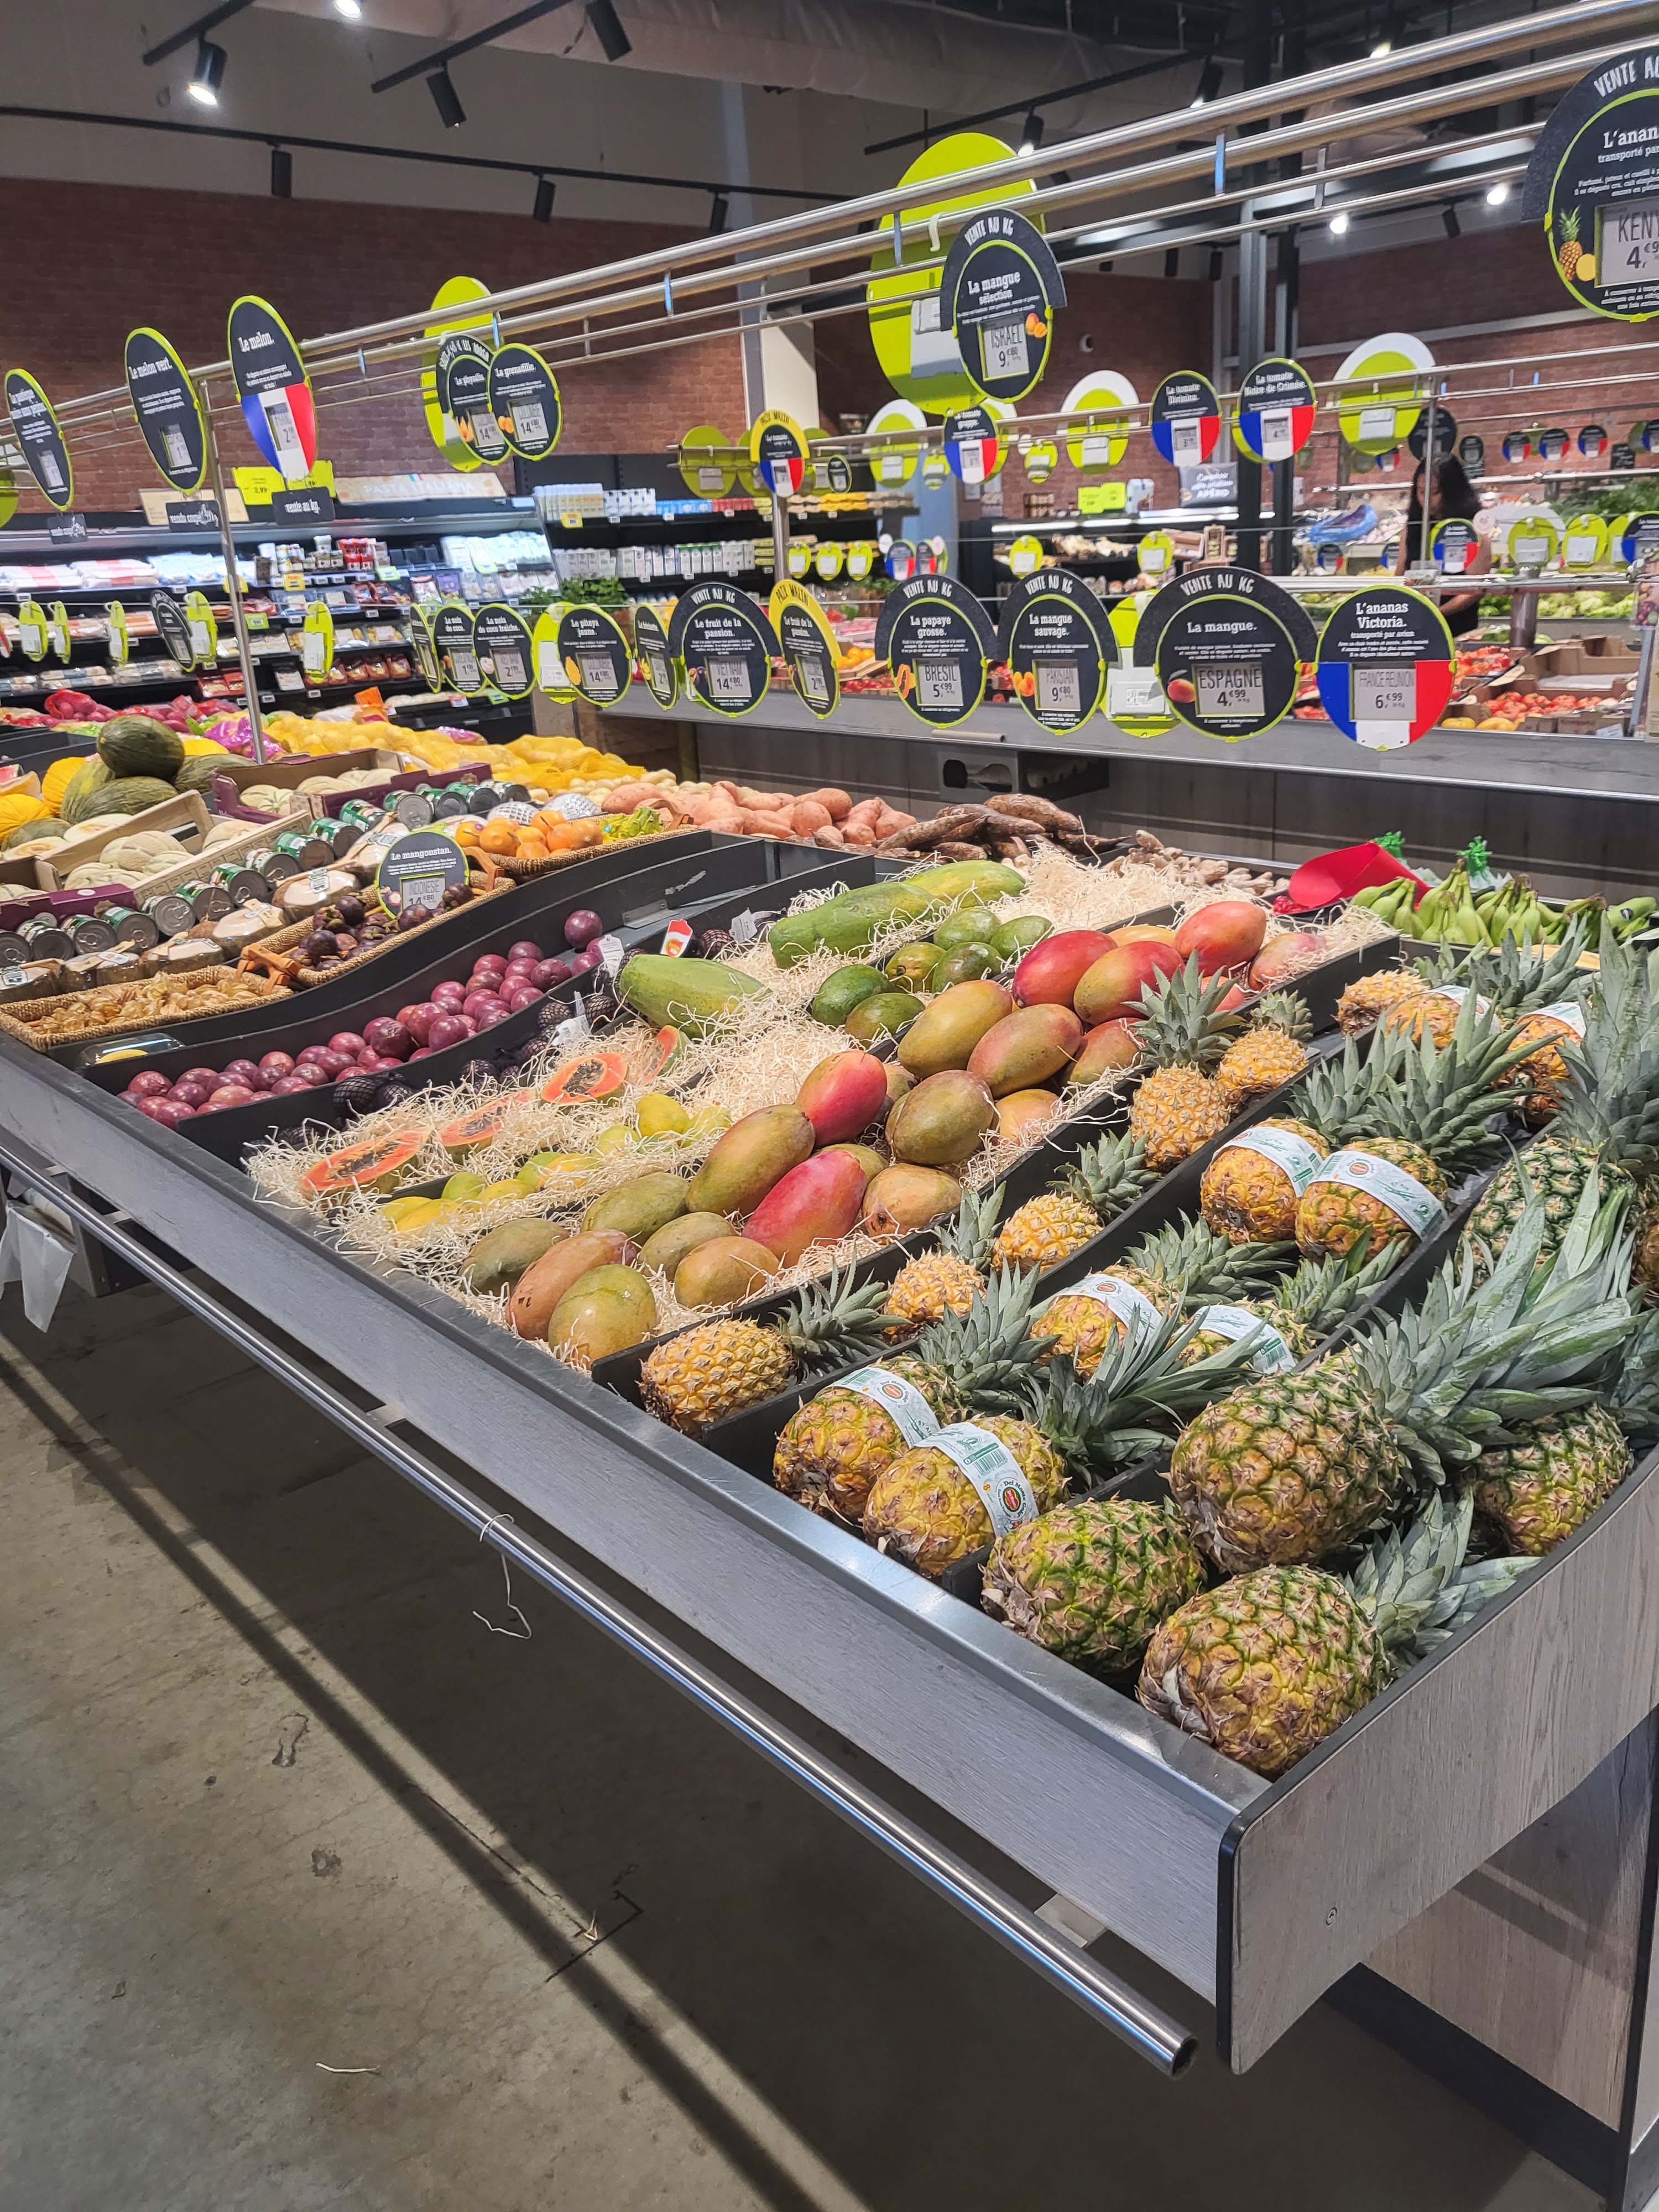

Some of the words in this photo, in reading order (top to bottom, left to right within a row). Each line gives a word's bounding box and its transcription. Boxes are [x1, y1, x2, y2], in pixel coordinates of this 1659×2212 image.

[1594, 60, 1636, 97] VENTE
[1598, 145, 1643, 163] transporté
[964, 220, 987, 246] VENTE
[988, 216, 999, 233] AU
[1002, 217, 1014, 236] KG
[968, 280, 980, 295] La
[981, 272, 1021, 290] mangue
[990, 324, 1023, 349] ISRAEL
[138, 361, 157, 378] melon
[903, 579, 925, 598] VENTE
[927, 579, 938, 593] AU
[941, 581, 953, 597] KG
[1025, 575, 1046, 596] VENTE
[1048, 574, 1060, 589] AU
[1061, 577, 1073, 594] KG
[1180, 575, 1213, 596] VENTE
[1217, 574, 1233, 588] AU
[1238, 576, 1255, 593] KG
[691, 588, 711, 604] VENTE
[712, 587, 723, 600] AU
[726, 589, 735, 603] KG
[1355, 602, 1408, 615] L'ananas
[570, 619, 579, 628] Le
[580, 619, 599, 629] pitaya
[695, 618, 704, 628] Le
[705, 618, 722, 628] fruit
[723, 618, 732, 628] de
[733, 618, 742, 627] la
[910, 615, 921, 625] La
[921, 615, 951, 629] papaye
[1029, 613, 1040, 624] La
[1041, 613, 1073, 627] mangue
[1357, 615, 1407, 629] Victoria.
[576, 628, 598, 638] jaune.
[704, 629, 735, 639] passion.
[917, 626, 947, 639] grosse.
[1034, 626, 1069, 639] sauvage.
[1187, 622, 1202, 633] La
[1204, 622, 1257, 634] mangue.
[1350, 630, 1383, 640] transporté
[925, 664, 957, 681] BRESIL
[1199, 668, 1261, 689] ESPAGNE
[390, 852, 401, 860] Le
[402, 847, 452, 858] mangoustan.
[409, 880, 440, 895] INDONESIE
[1015, 1482, 1026, 1501] Monte
[1017, 1503, 1026, 1518] Gold
